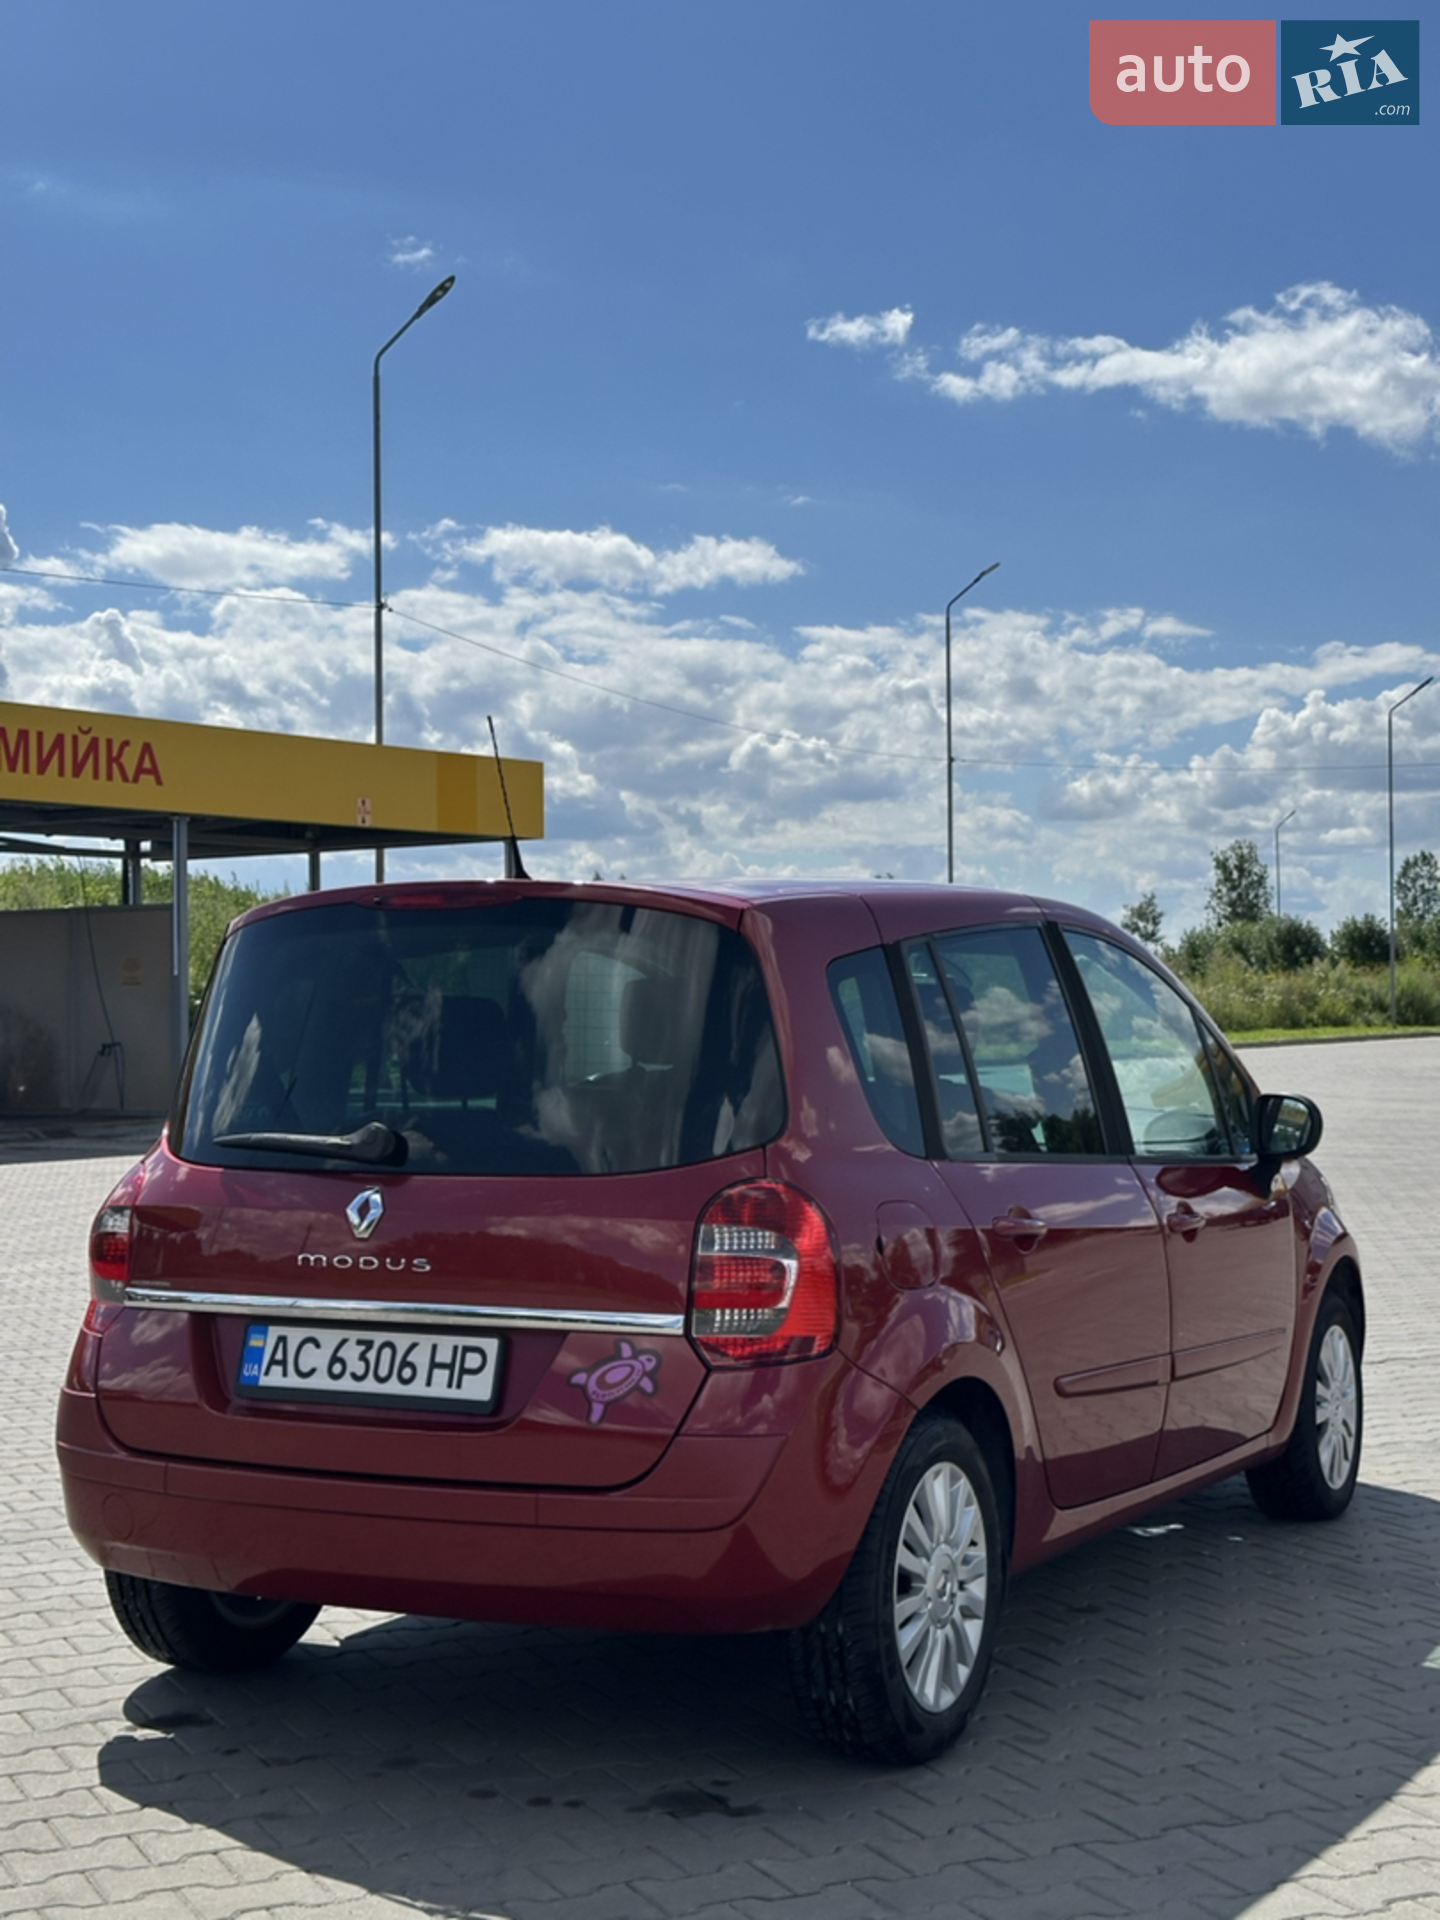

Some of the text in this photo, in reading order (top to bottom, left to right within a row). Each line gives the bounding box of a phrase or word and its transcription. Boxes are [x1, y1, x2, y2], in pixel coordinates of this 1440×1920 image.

[0, 725, 164, 786] МИЙКА
[243, 1363, 259, 1377] UA
[264, 1335, 322, 1379] AC
[327, 1338, 420, 1385] 6306
